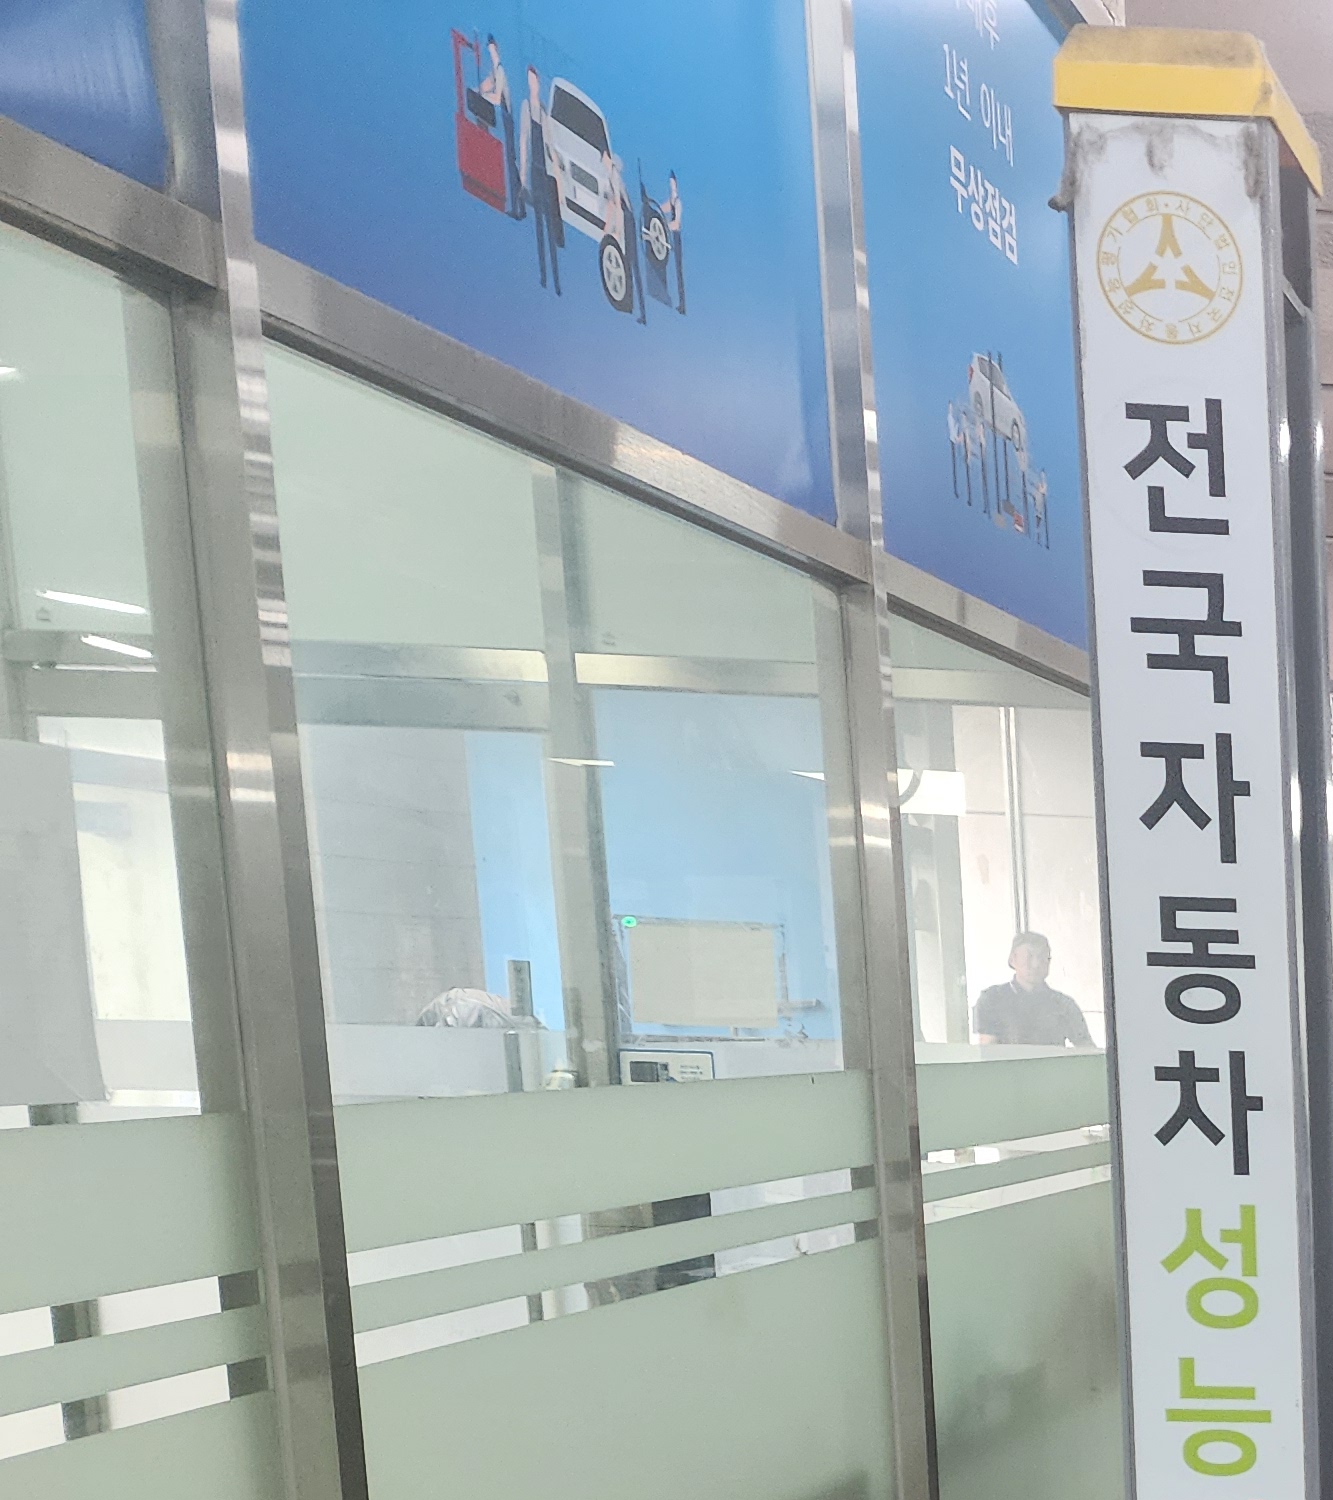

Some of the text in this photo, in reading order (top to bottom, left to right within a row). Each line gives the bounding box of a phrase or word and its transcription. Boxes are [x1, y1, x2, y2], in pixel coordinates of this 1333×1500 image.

[943, 43, 1014, 167] 1년 이내
[950, 144, 1018, 265] 무상점검
